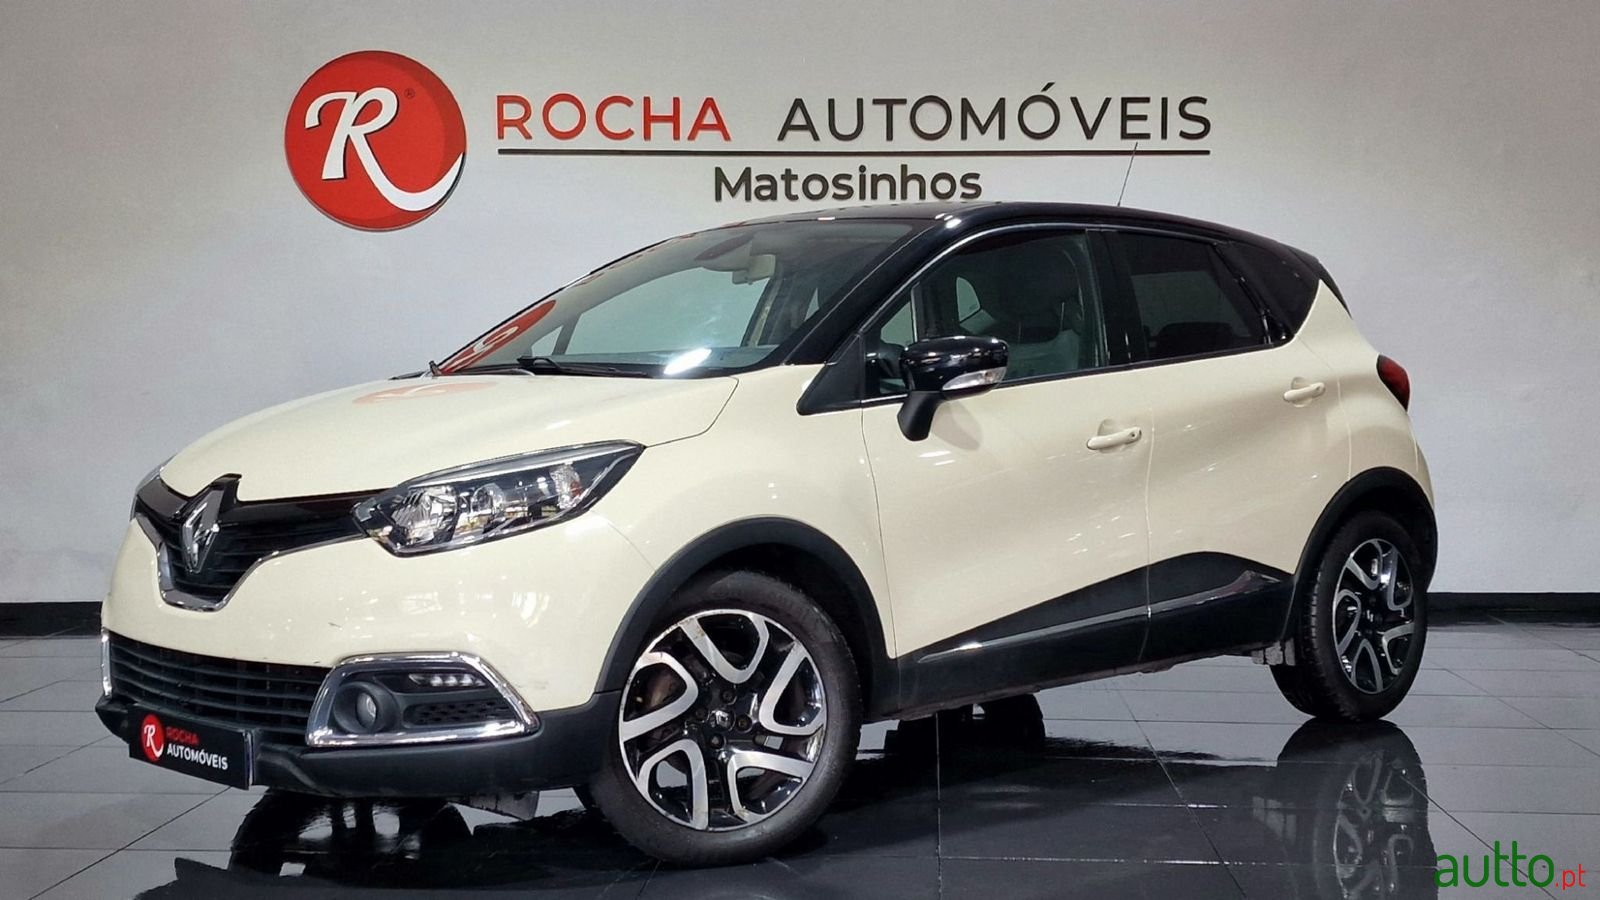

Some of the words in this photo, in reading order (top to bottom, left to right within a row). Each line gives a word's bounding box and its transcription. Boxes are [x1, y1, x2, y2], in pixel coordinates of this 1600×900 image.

[496, 93, 732, 142] ROCHA
[777, 82, 1212, 142] AUTOMÓVEIS
[714, 164, 982, 203] Matosinhos
[166, 727, 199, 745] ROCHA
[167, 743, 228, 770] AUTOMÓVEIS
